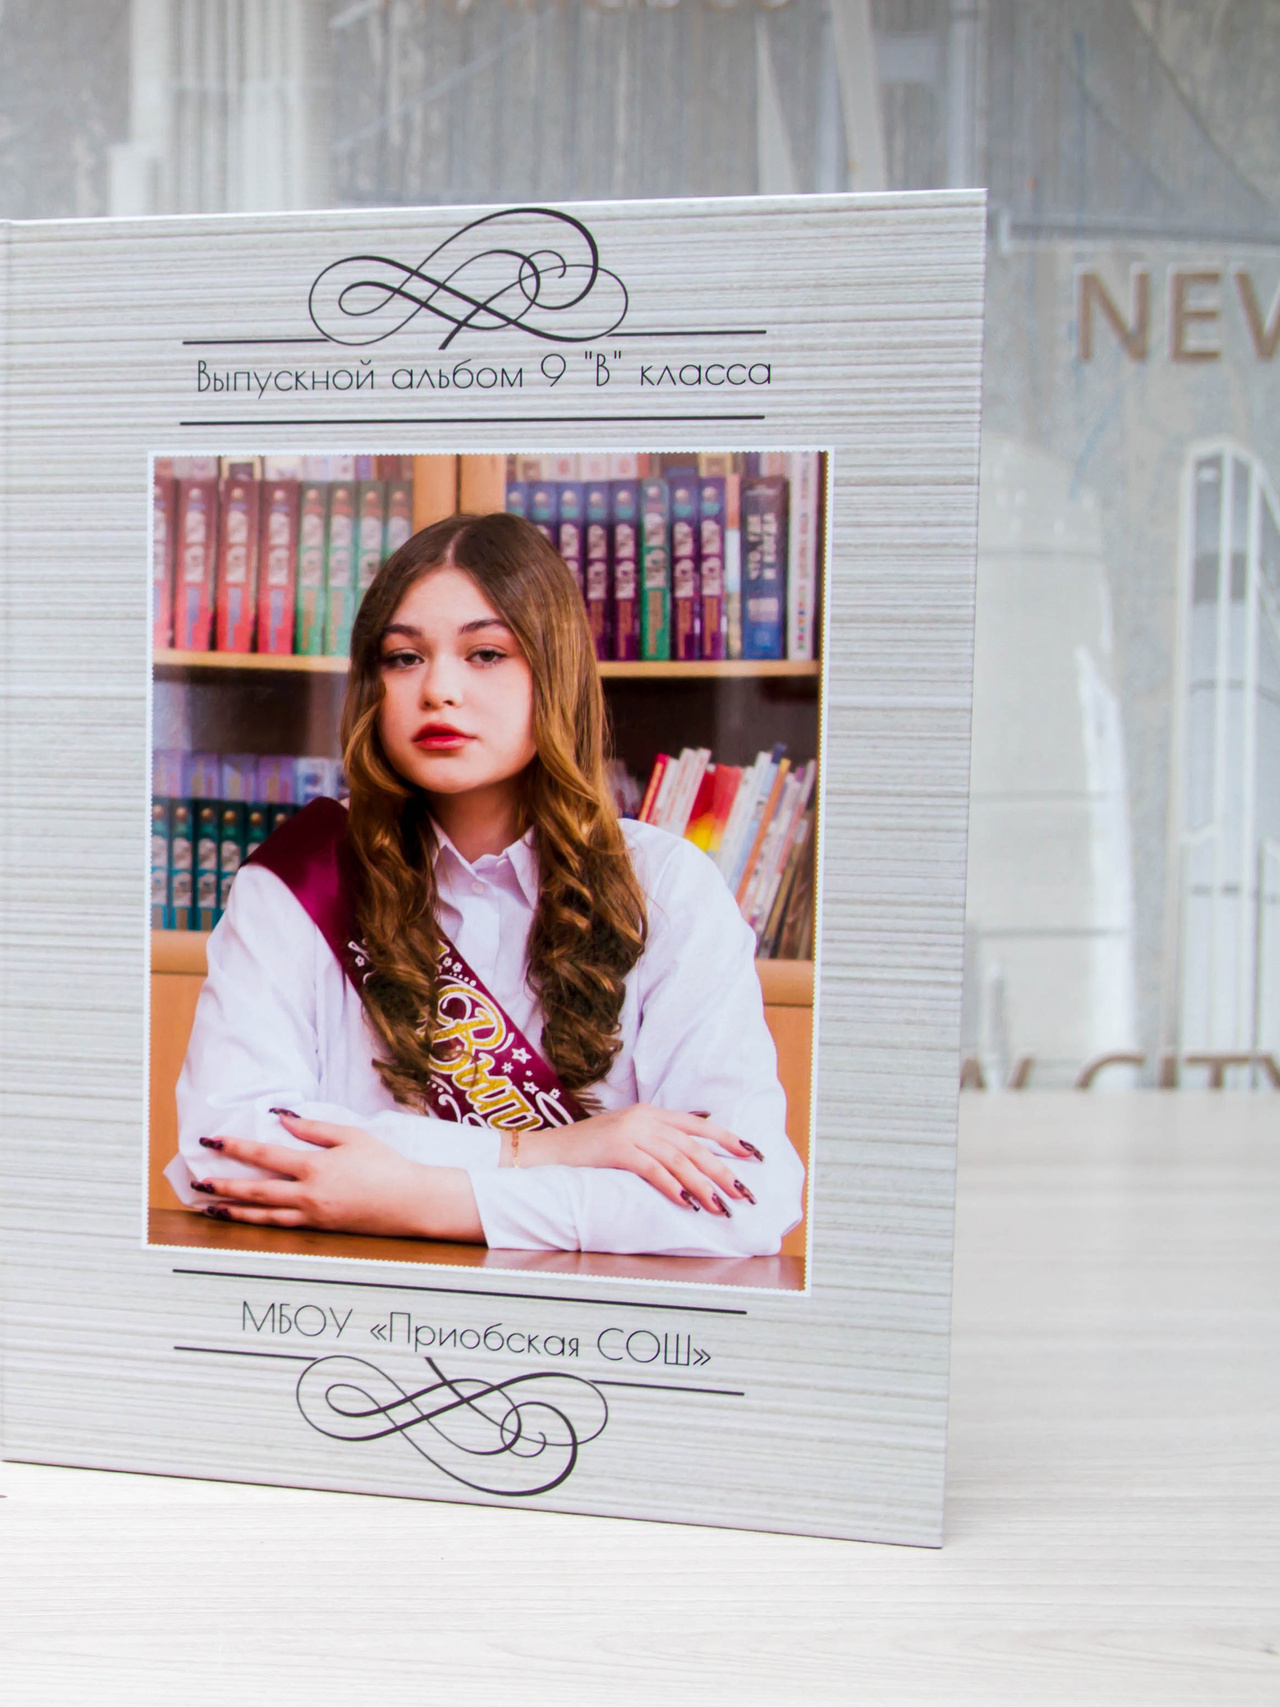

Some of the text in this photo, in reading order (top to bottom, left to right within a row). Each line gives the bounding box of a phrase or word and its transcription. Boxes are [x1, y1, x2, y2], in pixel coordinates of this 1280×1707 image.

[197, 359, 374, 399] Выпускной
[391, 358, 523, 390] альбом
[540, 353, 567, 387] 9
[640, 363, 772, 386] класса
[241, 1300, 712, 1366] МБОУ «Приобская СОШ»
